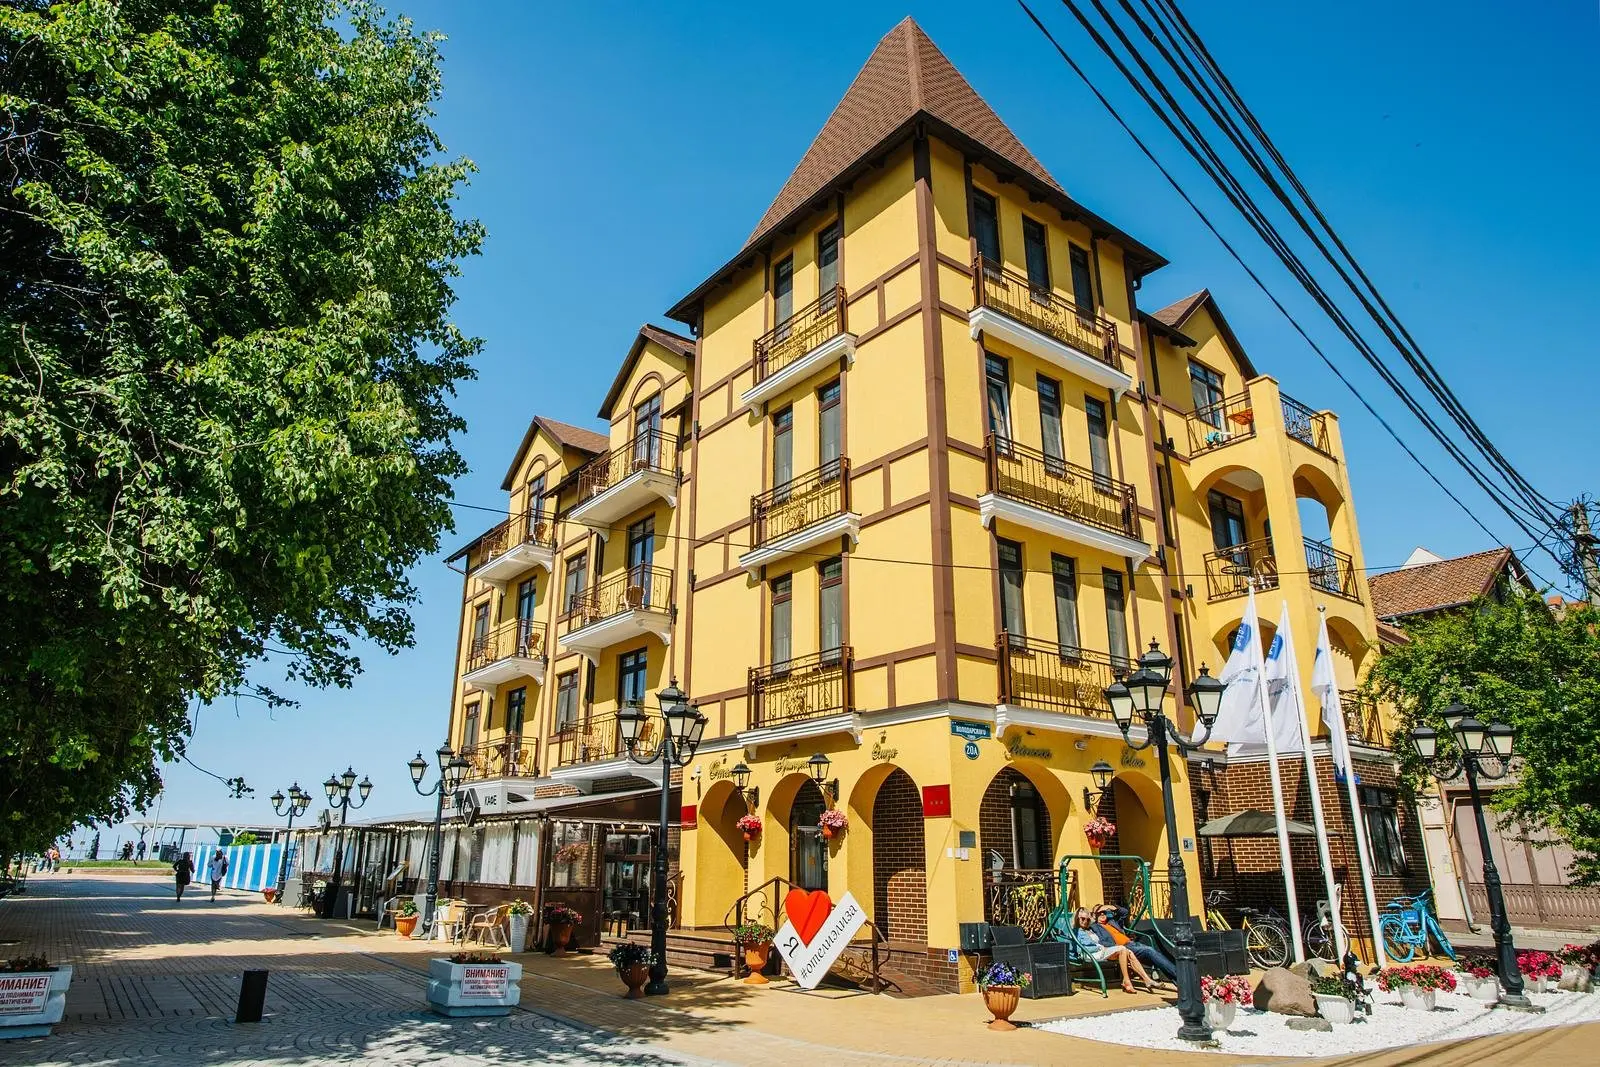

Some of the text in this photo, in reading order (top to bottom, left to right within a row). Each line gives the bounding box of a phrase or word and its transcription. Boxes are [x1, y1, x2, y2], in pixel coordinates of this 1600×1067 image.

[966, 746, 978, 756] 20А
[800, 904, 858, 981] #отелиэлиза
[466, 970, 506, 978] ВНИМАНИЕ!
